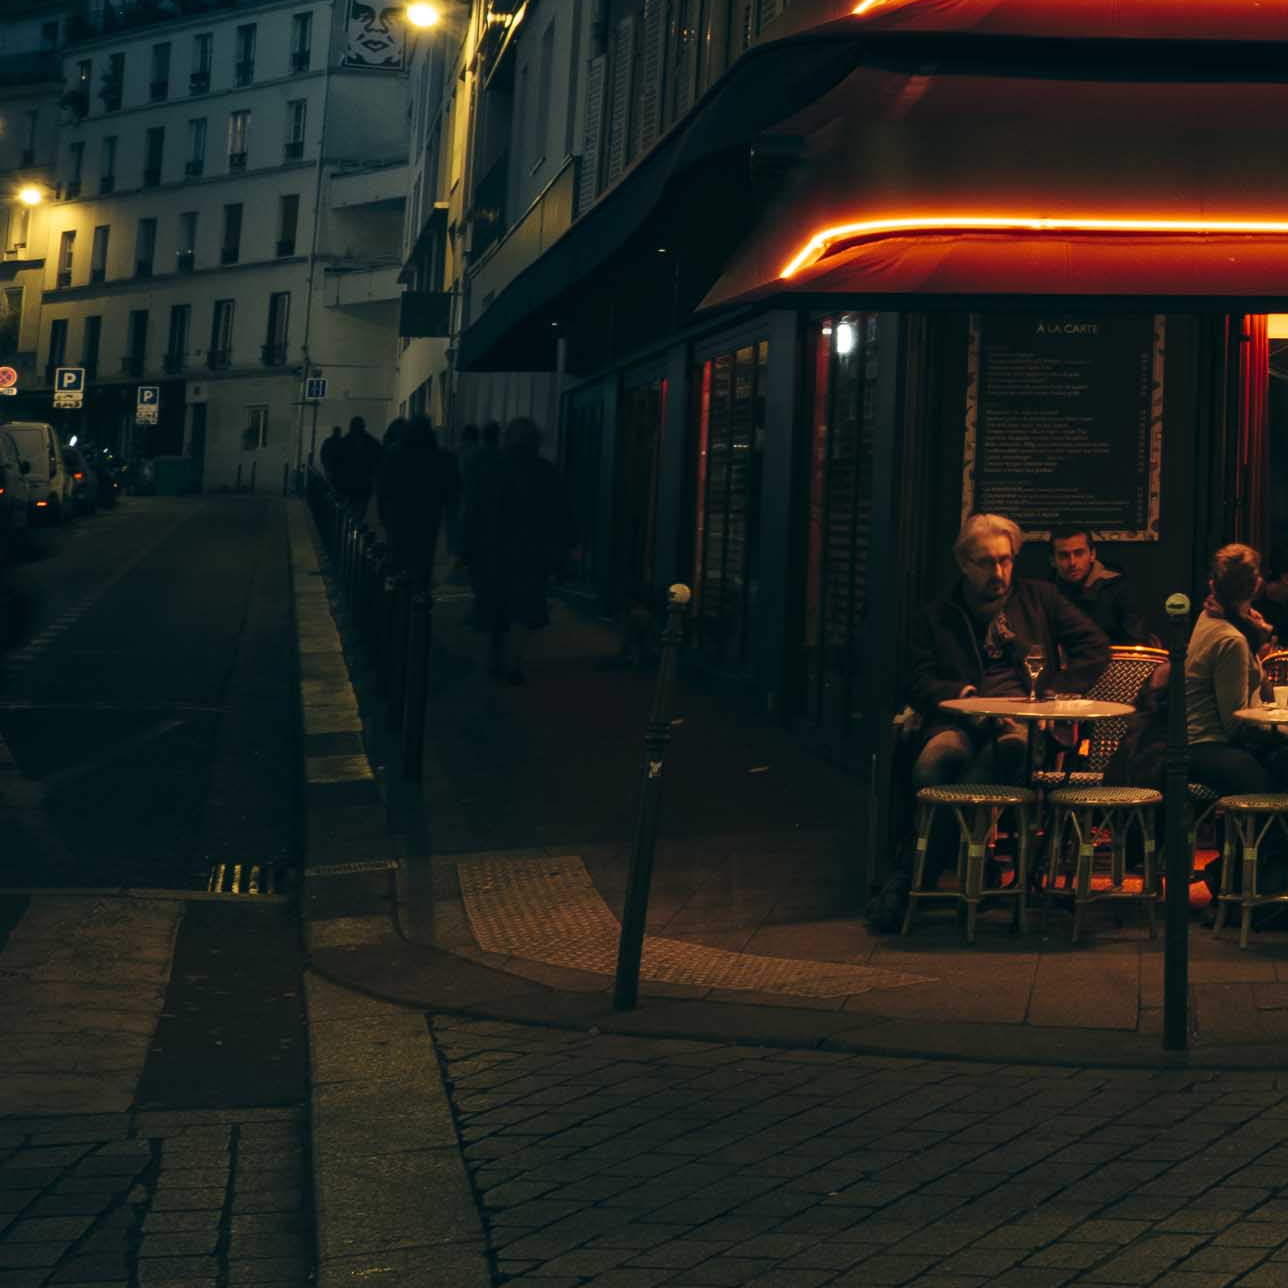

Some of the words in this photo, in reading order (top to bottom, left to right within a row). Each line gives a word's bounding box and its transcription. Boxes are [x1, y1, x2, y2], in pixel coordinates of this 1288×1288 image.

[1064, 323, 1098, 334] CARTE
[63, 373, 77, 388] P
[143, 391, 153, 402] P
